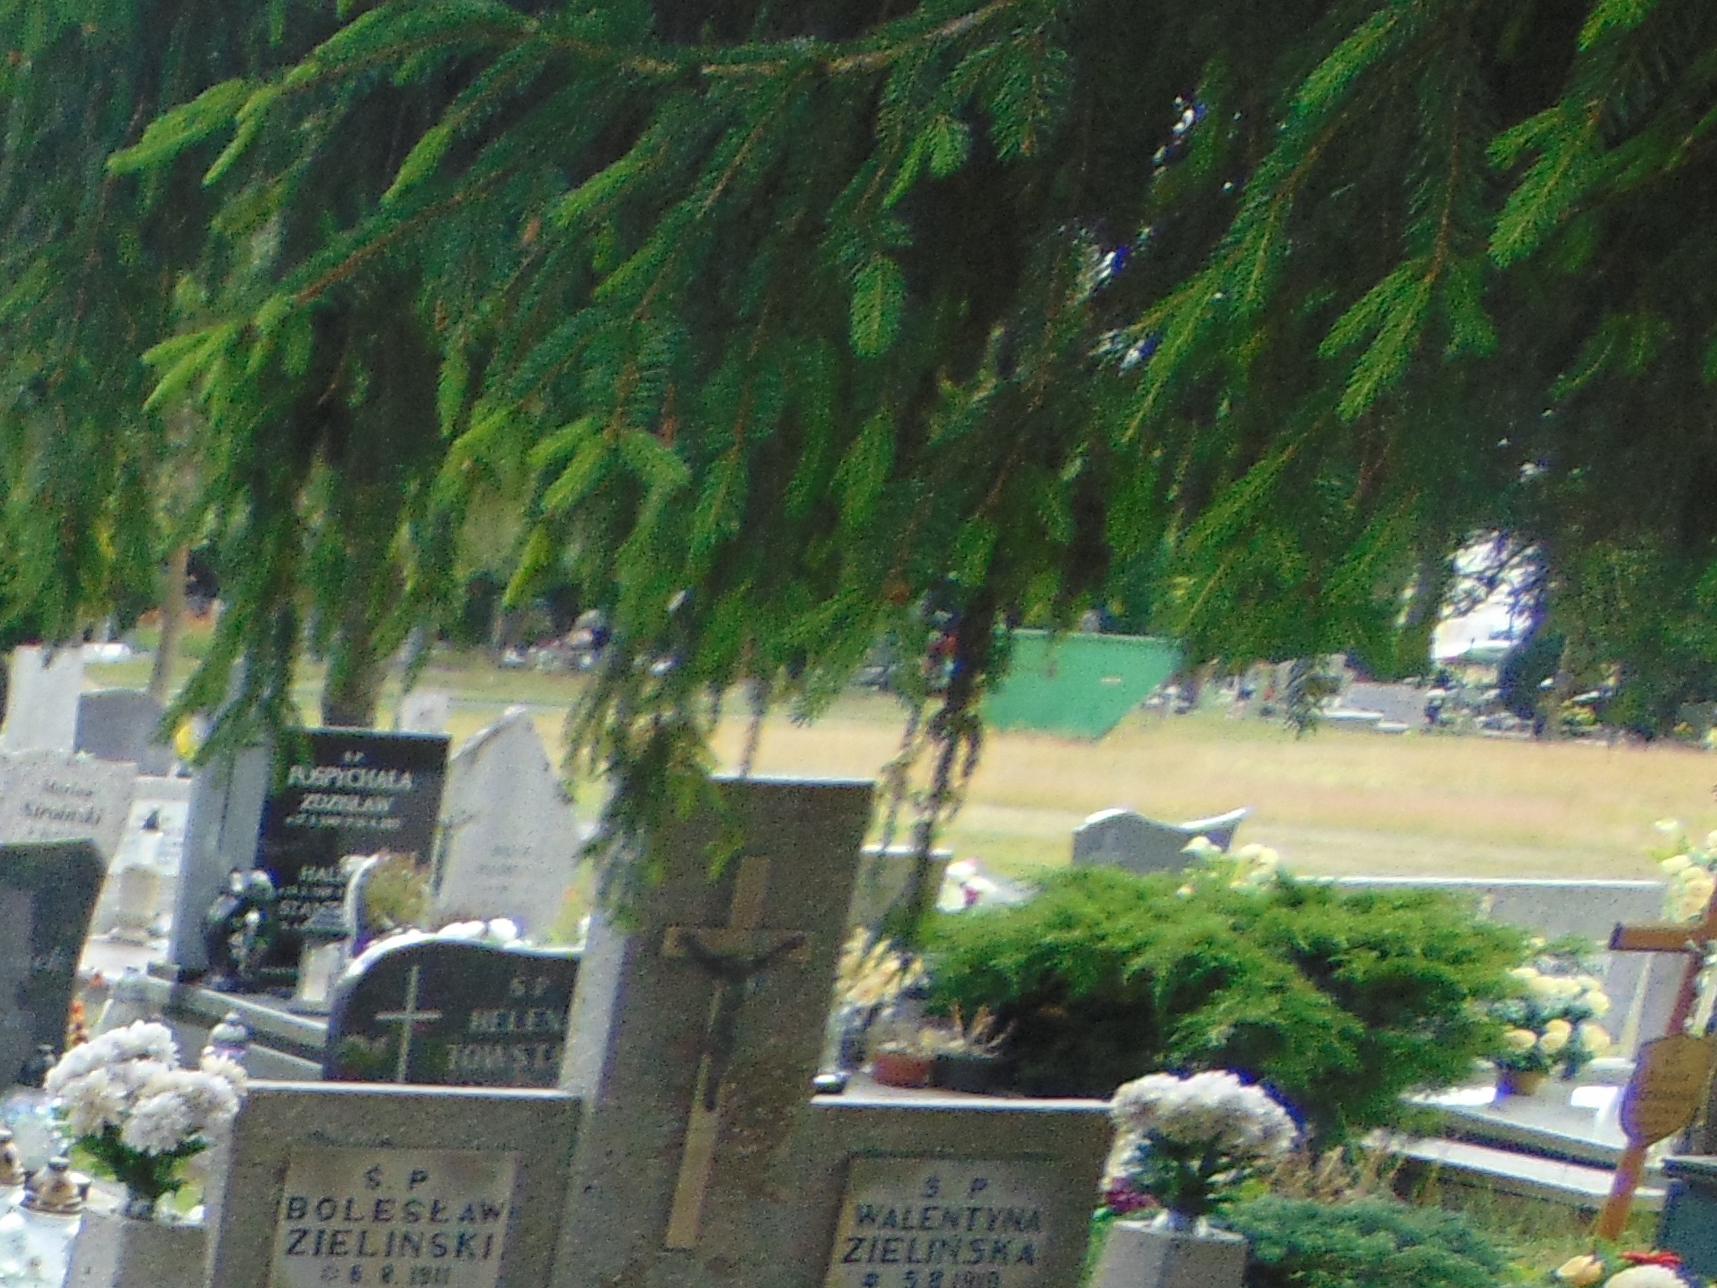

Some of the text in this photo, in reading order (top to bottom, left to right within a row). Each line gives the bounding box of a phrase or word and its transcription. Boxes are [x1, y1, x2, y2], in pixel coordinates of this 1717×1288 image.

[469, 1007, 564, 1032] HELEN
[285, 1196, 505, 1224] BOLESŁAW
[857, 1202, 1042, 1233] WALENTYNA
